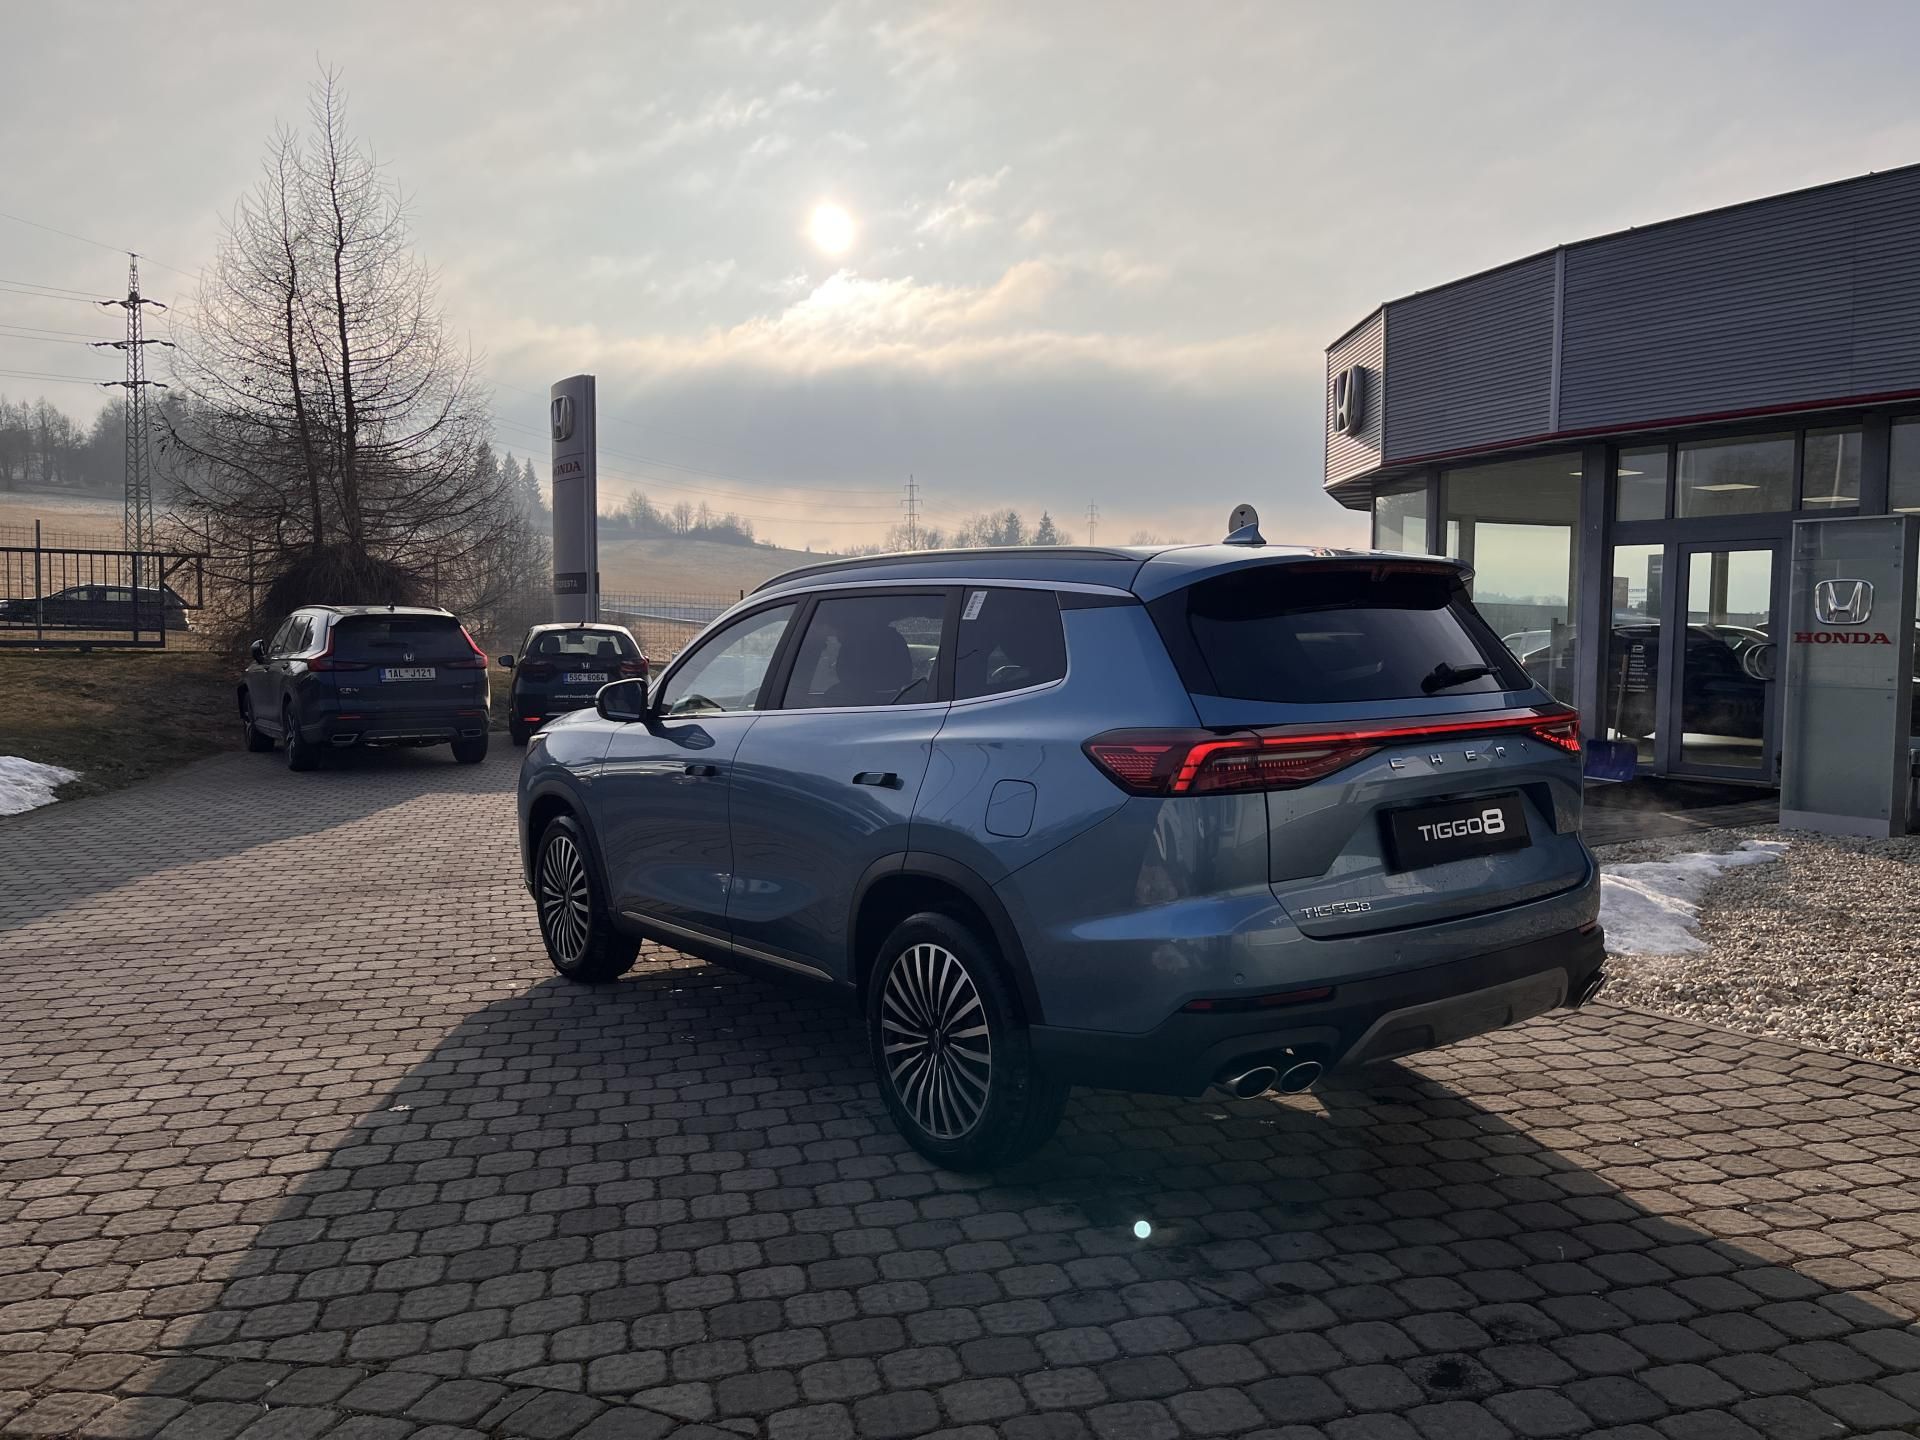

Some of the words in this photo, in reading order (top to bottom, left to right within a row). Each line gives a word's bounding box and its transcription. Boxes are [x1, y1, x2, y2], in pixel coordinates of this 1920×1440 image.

[1794, 632, 1892, 644] HONDA
[410, 668, 432, 678] J121
[1389, 743, 1529, 770] CHERY
[1417, 808, 1505, 841] TIGGO8
